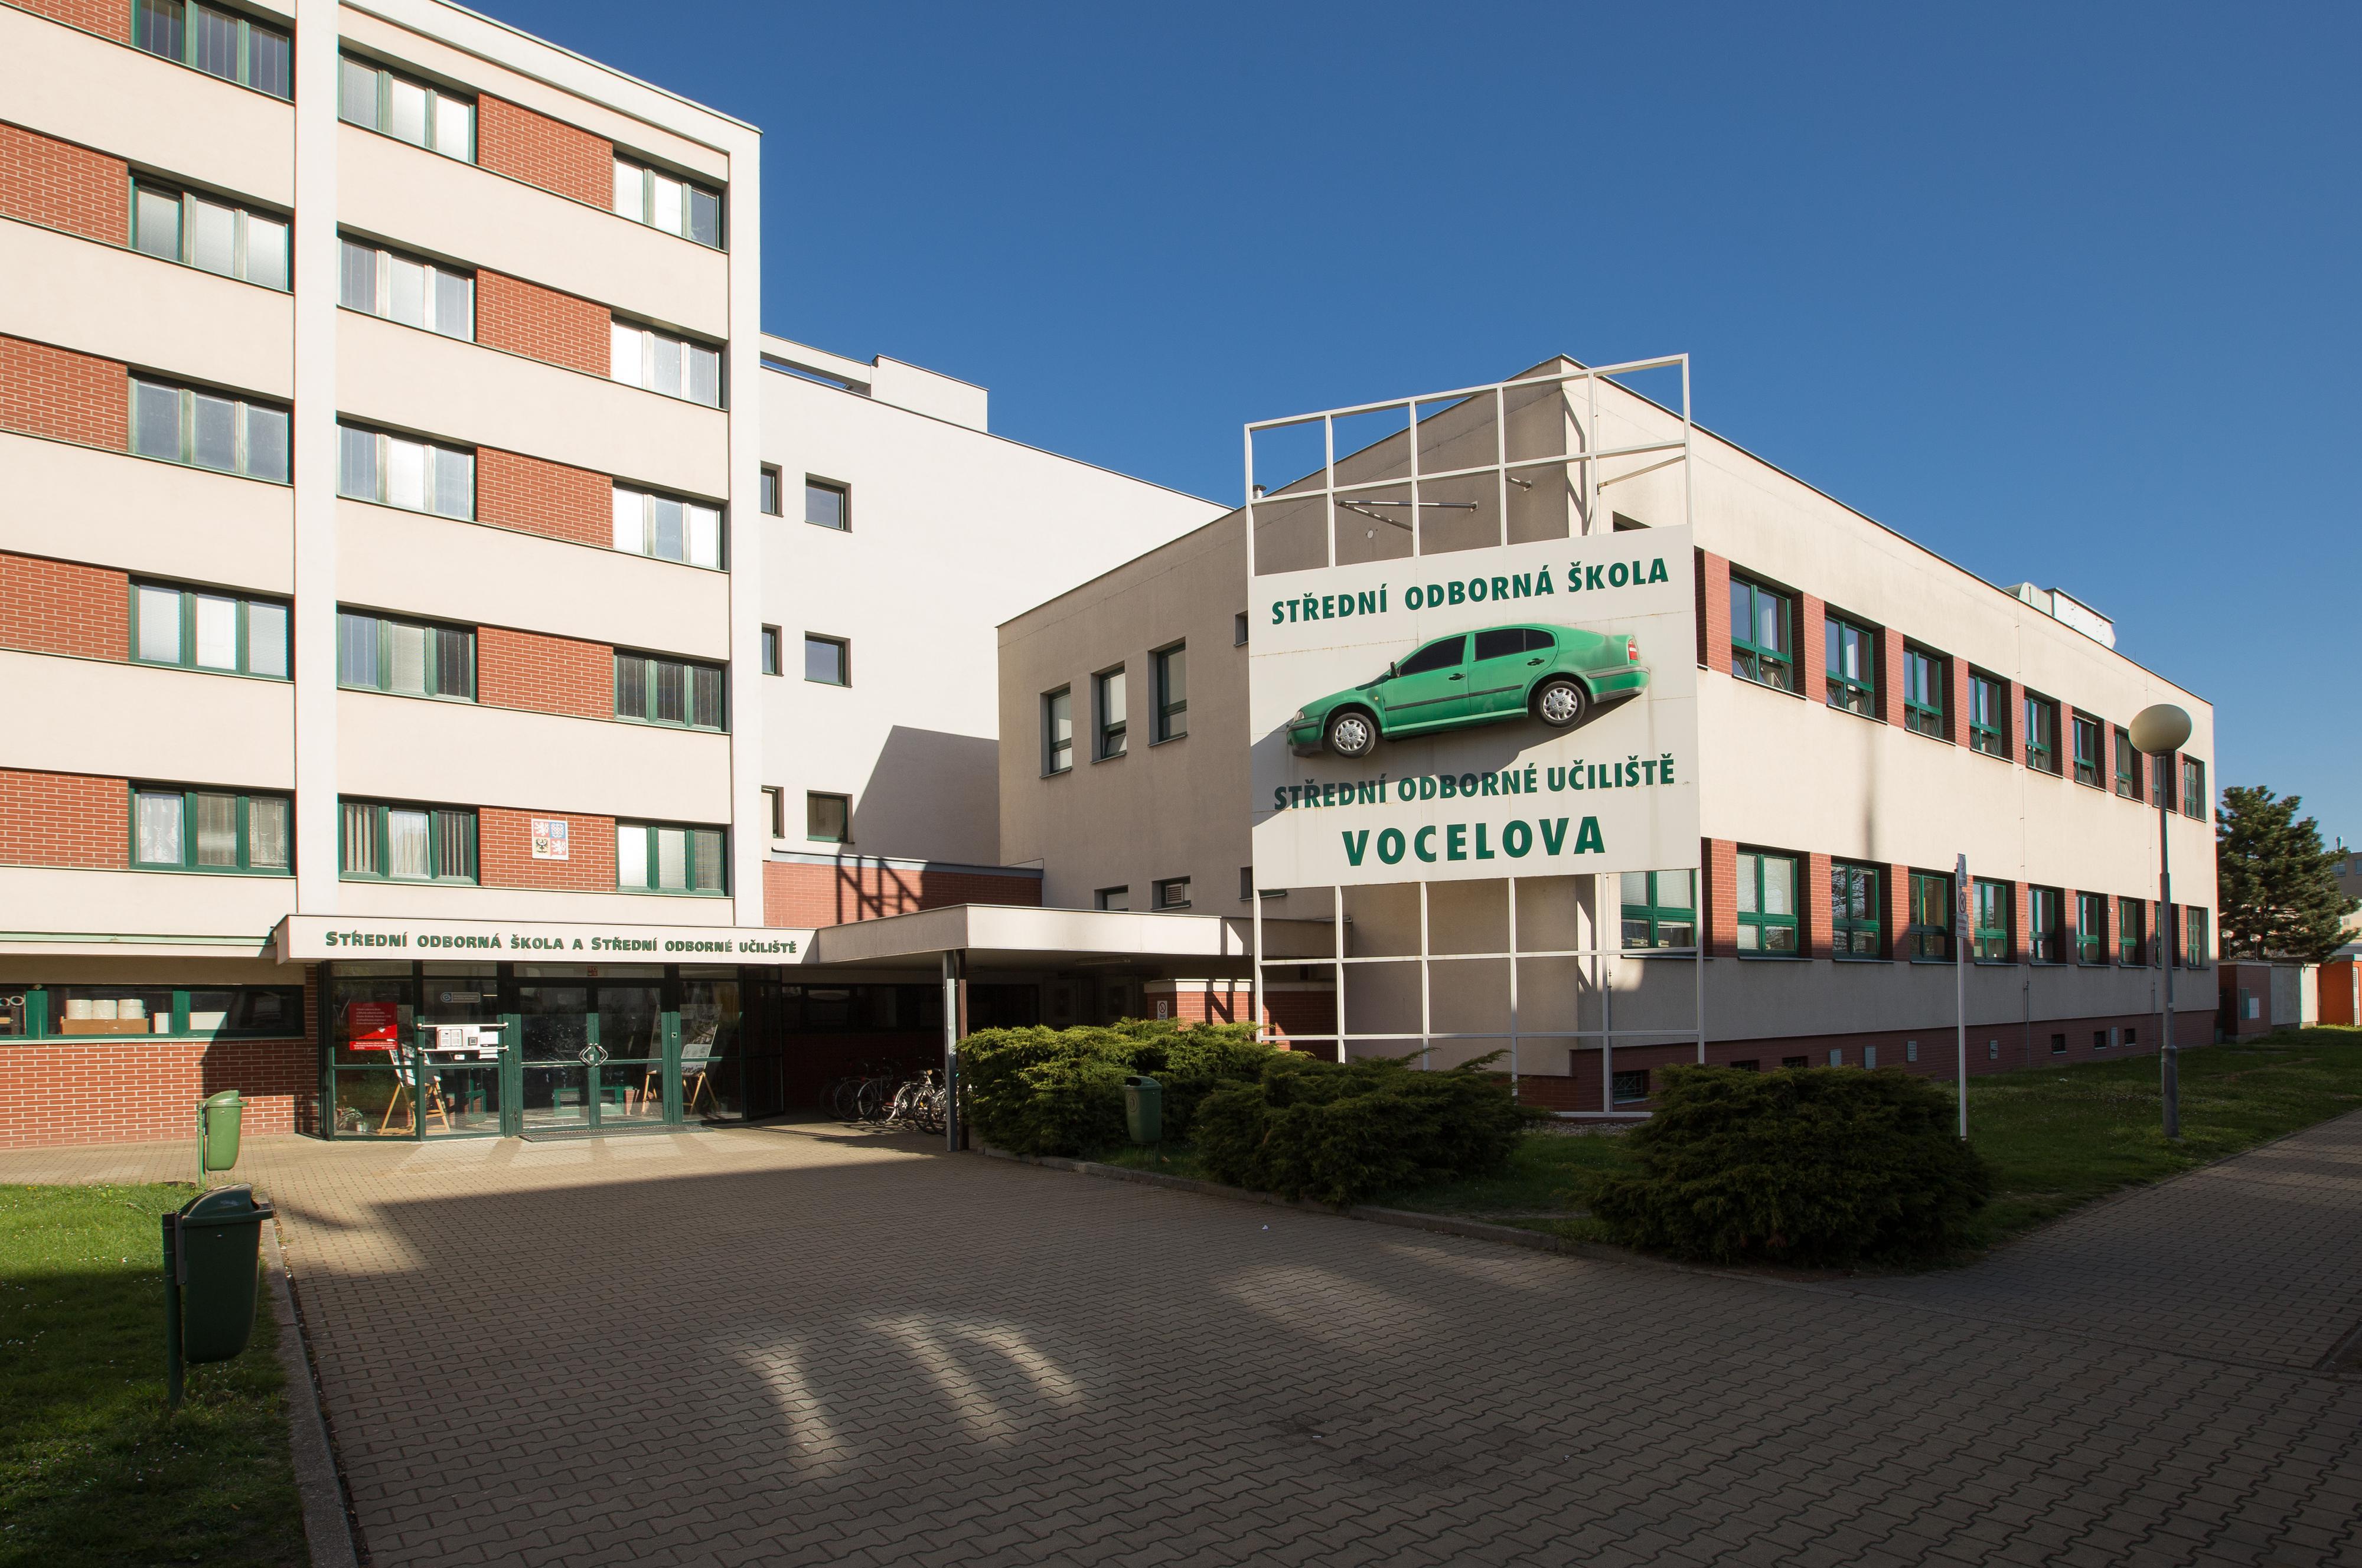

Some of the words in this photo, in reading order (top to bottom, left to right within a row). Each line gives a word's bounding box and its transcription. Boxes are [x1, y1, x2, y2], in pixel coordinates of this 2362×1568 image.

[1272, 583, 1388, 625] STŘEDNÍ
[1405, 564, 1554, 610] ODBORNÁ
[1568, 557, 1669, 593] ŠKOLA
[1274, 773, 1386, 810] STŘEDNÍ
[1398, 763, 1538, 802] ODBORNÉ
[1547, 753, 1675, 792] UČILIŠTĚ
[1342, 816, 1606, 867] VOCELOVA
[325, 930, 407, 948] STŘEDNÍ
[417, 933, 501, 949] ODBORNÁ
[511, 933, 563, 949] ŠKOLA
[572, 939, 583, 950] A
[591, 936, 657, 951] STŘEDNÍ
[665, 938, 732, 952] ODBORNÉ
[739, 939, 796, 953] UČILIŠTĚ
